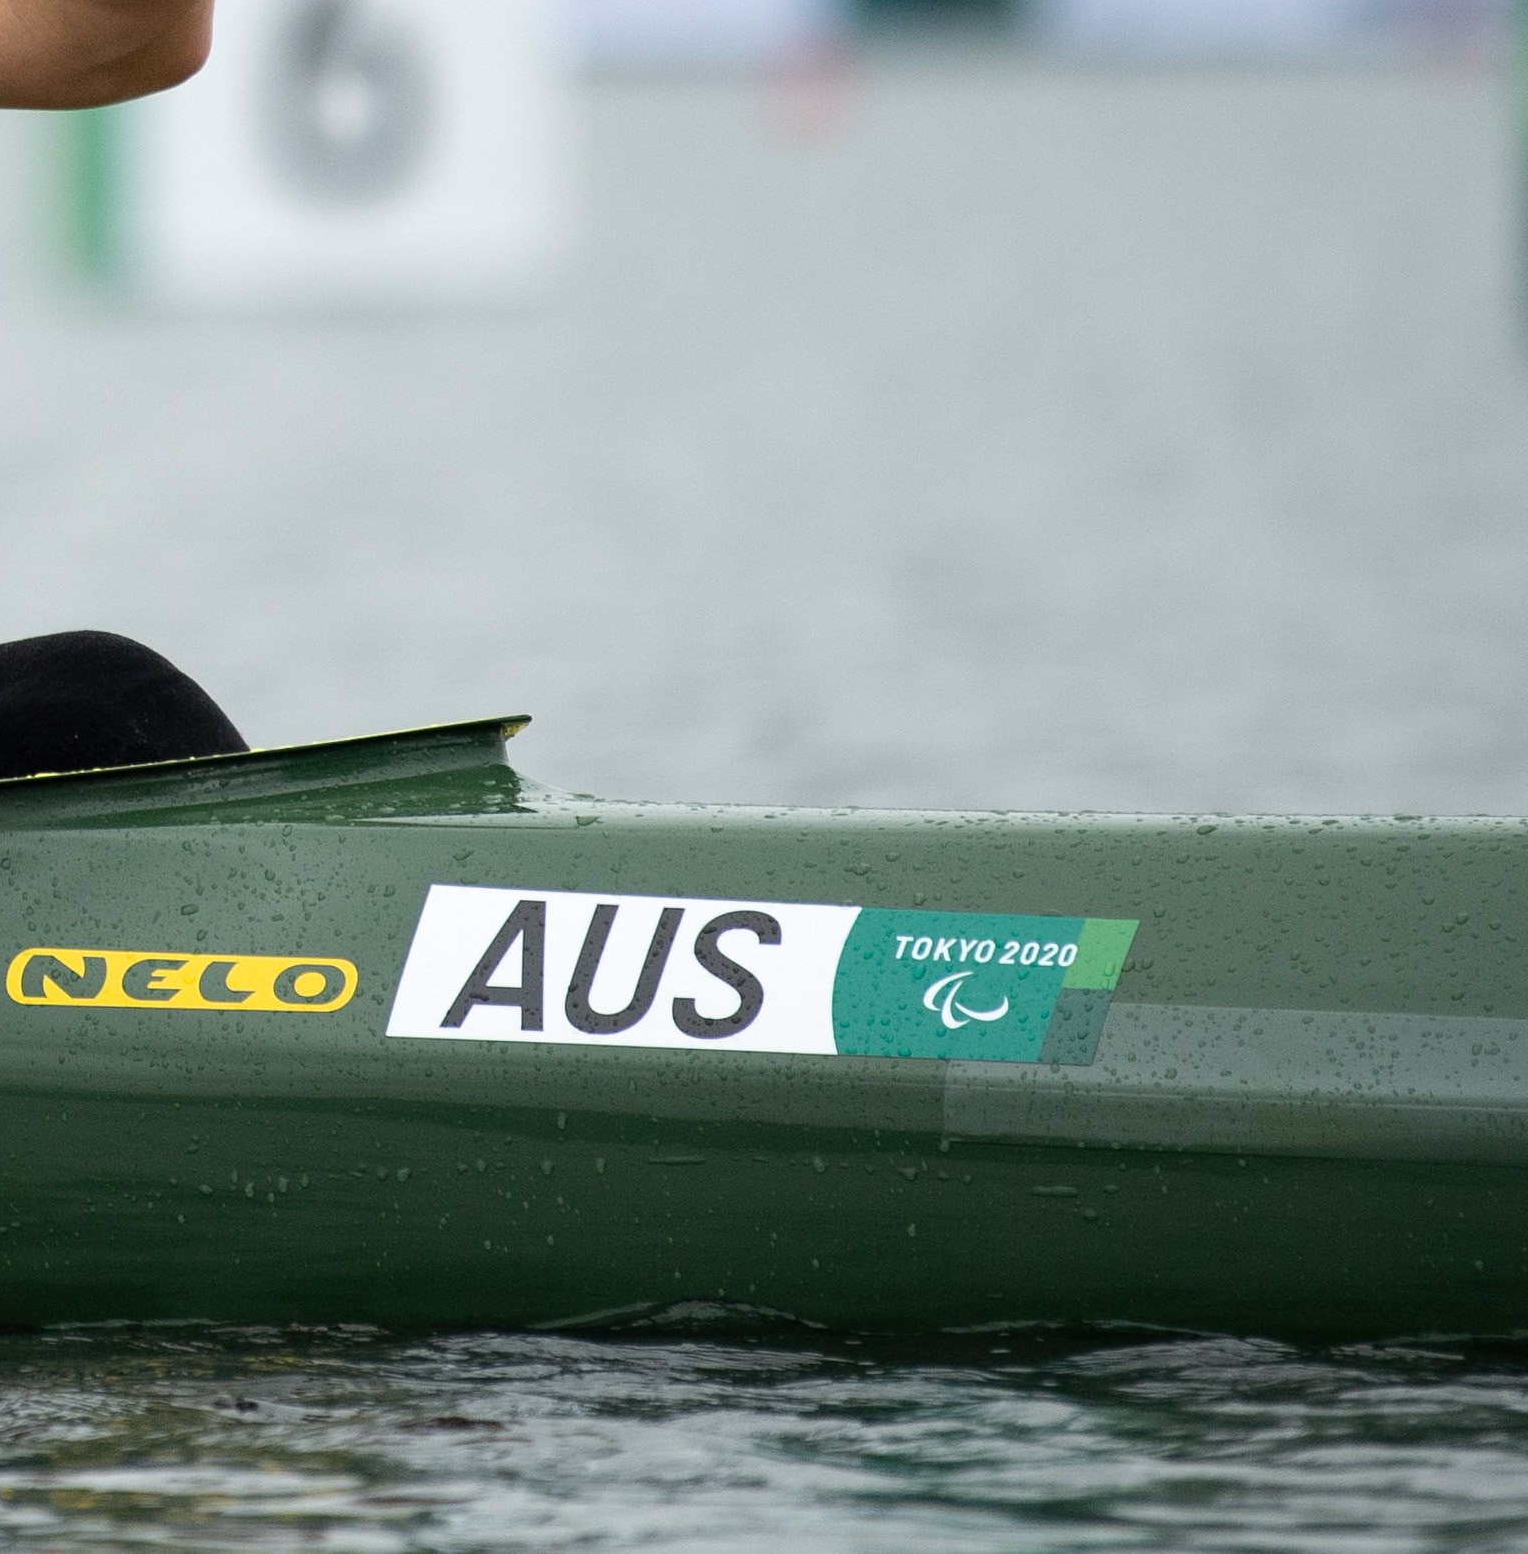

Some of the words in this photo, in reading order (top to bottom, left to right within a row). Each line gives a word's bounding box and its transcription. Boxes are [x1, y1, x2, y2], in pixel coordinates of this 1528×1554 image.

[438, 899, 784, 1040] AUS
[894, 935, 996, 964] TOKYO
[998, 940, 1079, 968] 2020
[20, 954, 346, 1005] NELO
